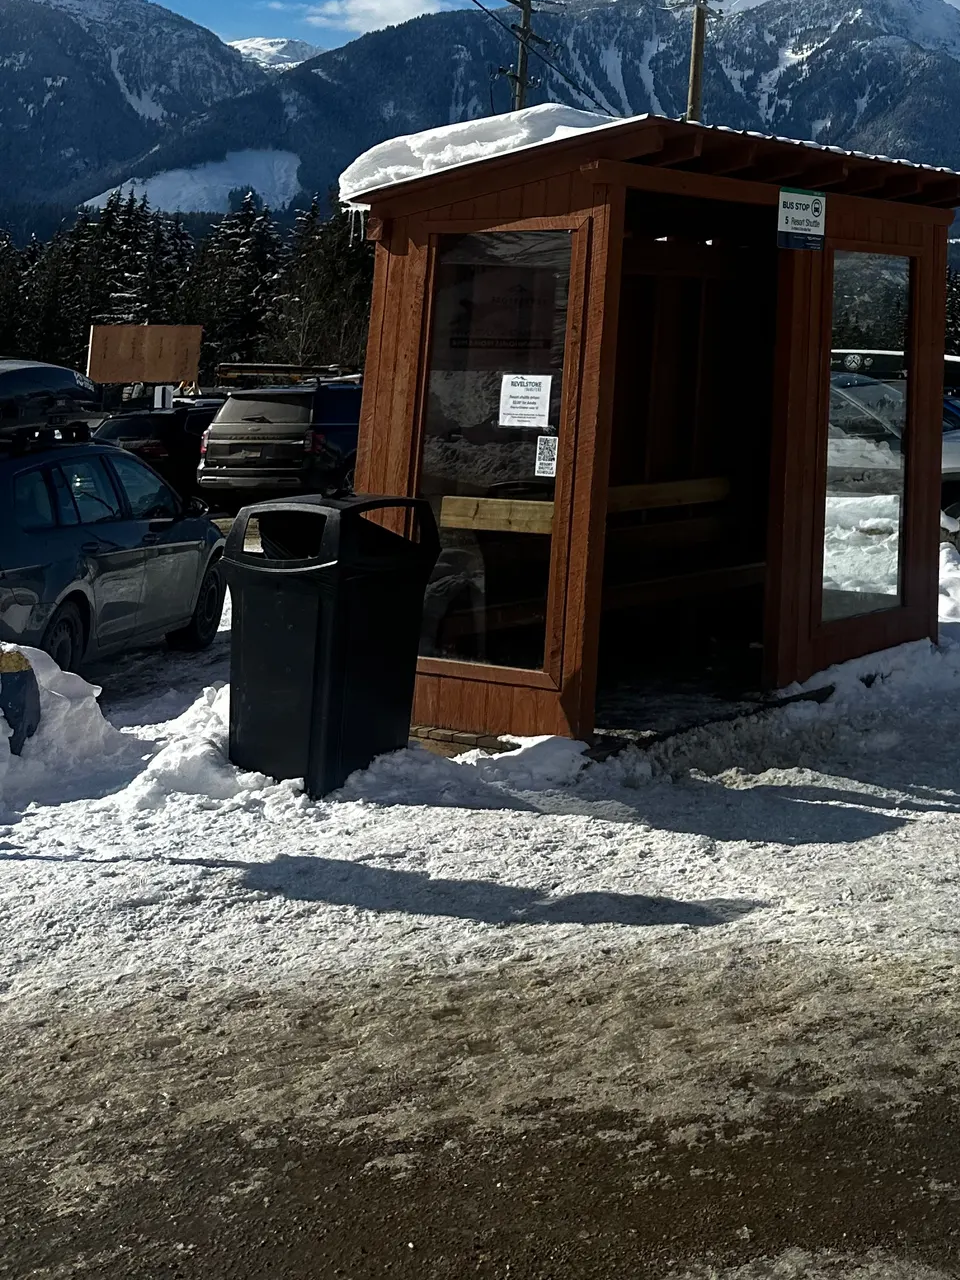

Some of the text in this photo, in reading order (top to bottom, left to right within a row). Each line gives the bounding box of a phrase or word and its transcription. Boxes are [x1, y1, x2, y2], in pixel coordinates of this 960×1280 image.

[783, 201, 810, 211] BUS STOP
[785, 216, 820, 227] 5 Resort Shuttle
